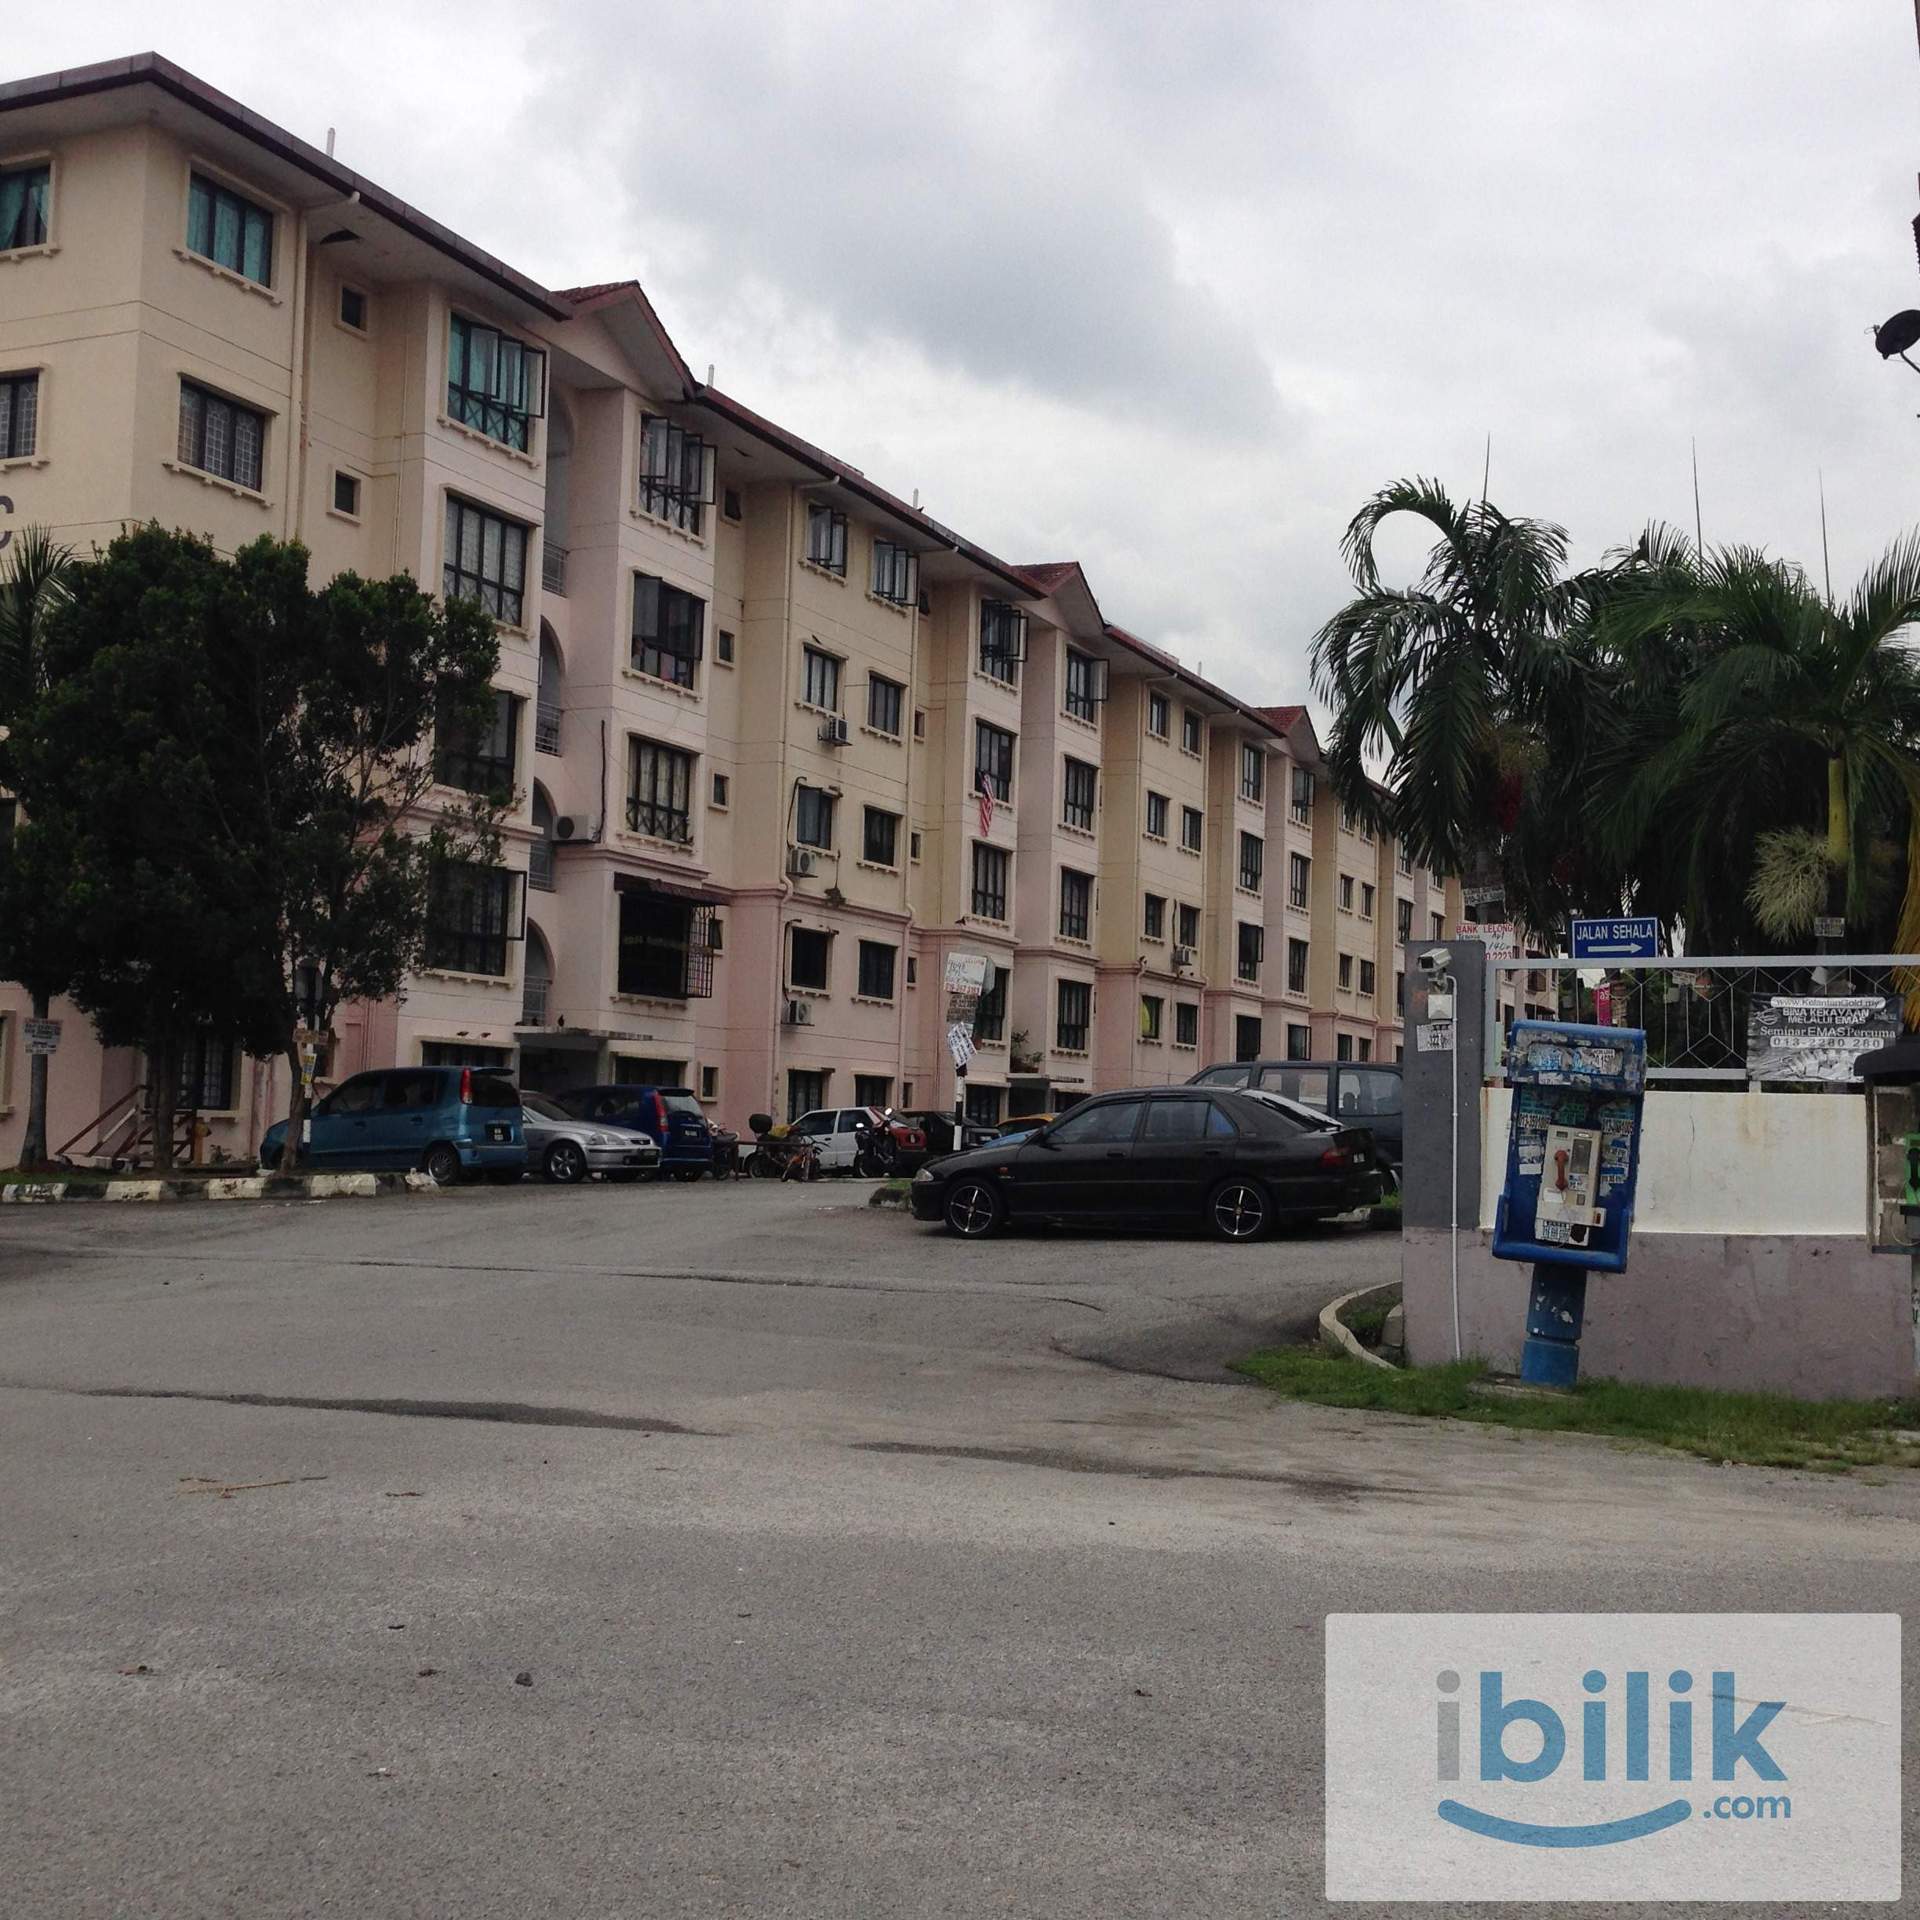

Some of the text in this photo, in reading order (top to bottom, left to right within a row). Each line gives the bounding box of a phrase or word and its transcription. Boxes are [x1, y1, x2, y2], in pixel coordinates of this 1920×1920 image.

[1456, 923, 1513, 933] BANK LELONG
[1577, 923, 1653, 940] JALAN SEHALA
[1782, 1008, 1808, 1017] BINA
[1809, 1008, 1870, 1017] KEKAYAAN
[1787, 1016, 1866, 1024] MELALUI EMAS
[1760, 1026, 1896, 1038] Seminar EMAS Percuma
[1773, 1037, 1880, 1048] 013-2280 280
